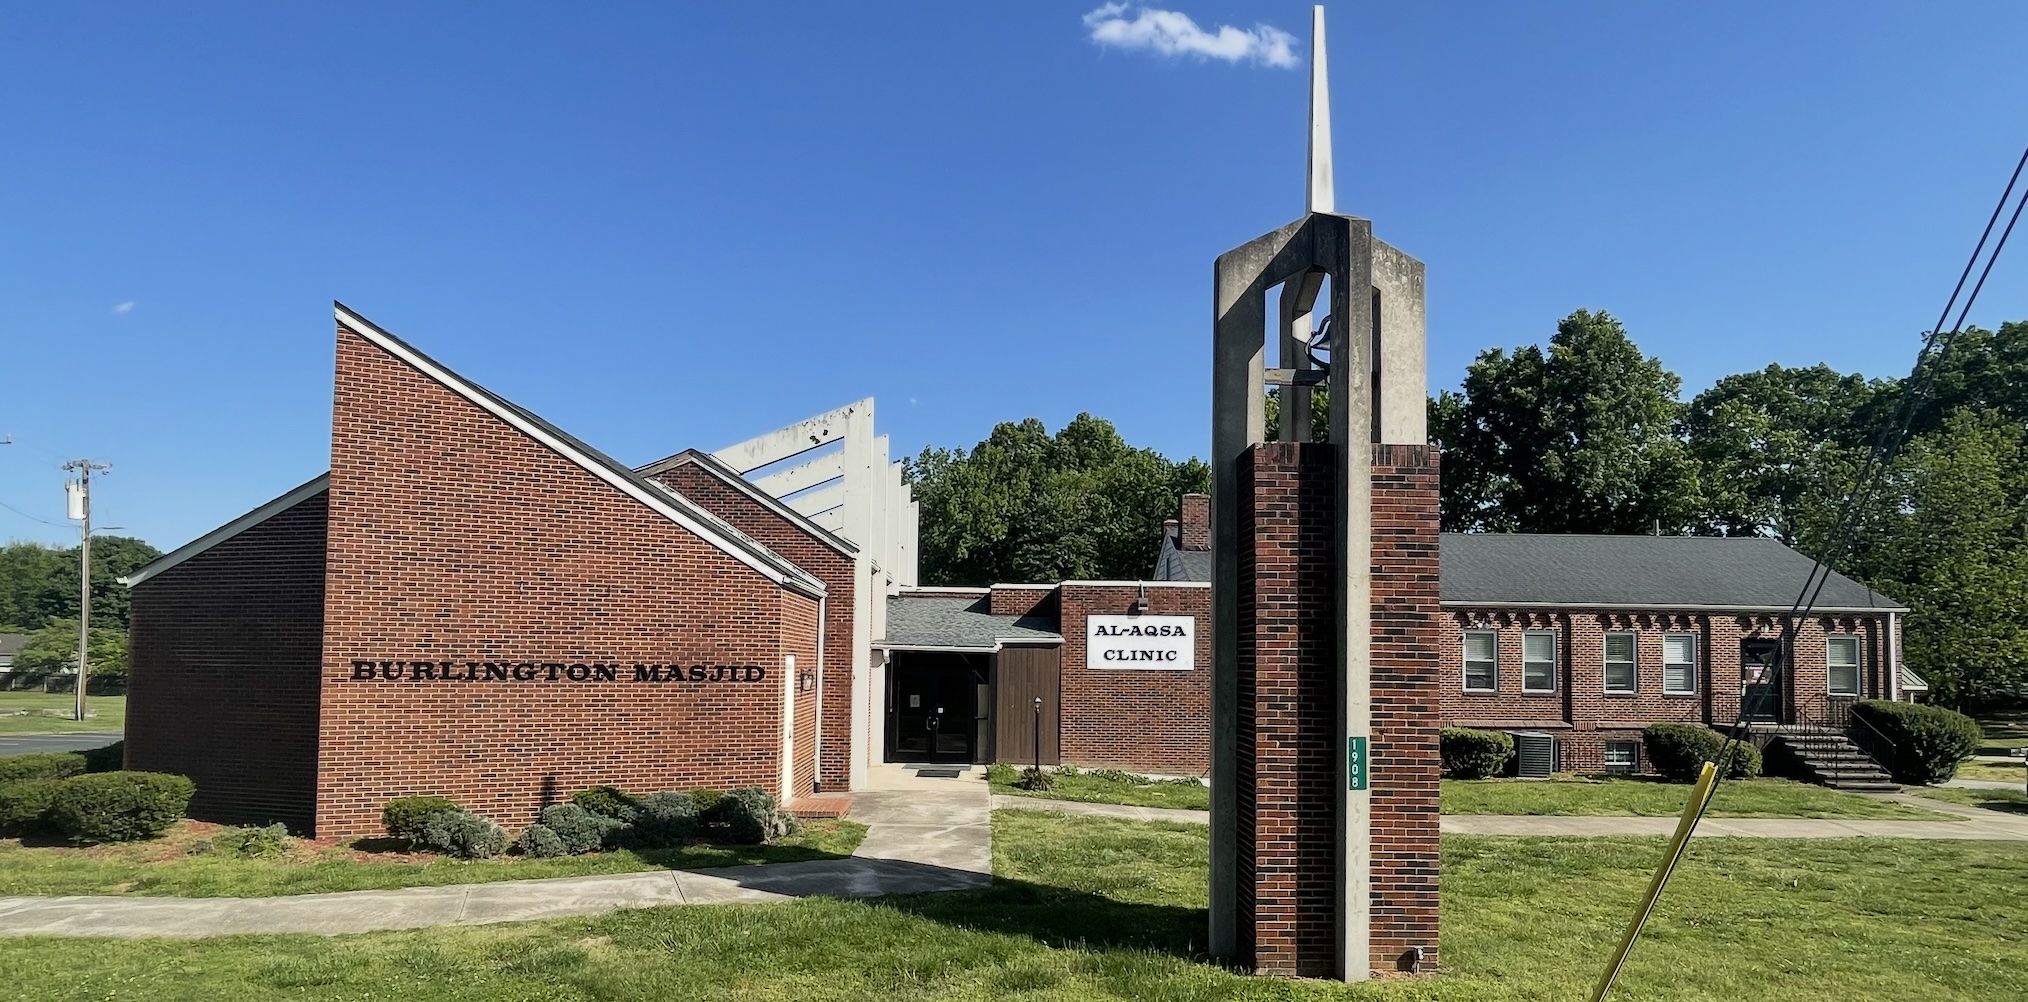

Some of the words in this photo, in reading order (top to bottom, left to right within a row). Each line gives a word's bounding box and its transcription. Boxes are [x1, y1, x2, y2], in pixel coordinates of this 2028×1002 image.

[1094, 625, 1187, 637] AL-AQSA
[1103, 649, 1177, 661] CLINIC
[350, 660, 620, 681] BURLINGTON
[633, 663, 766, 683] MASJID
[1351, 739, 1359, 788] 1908
